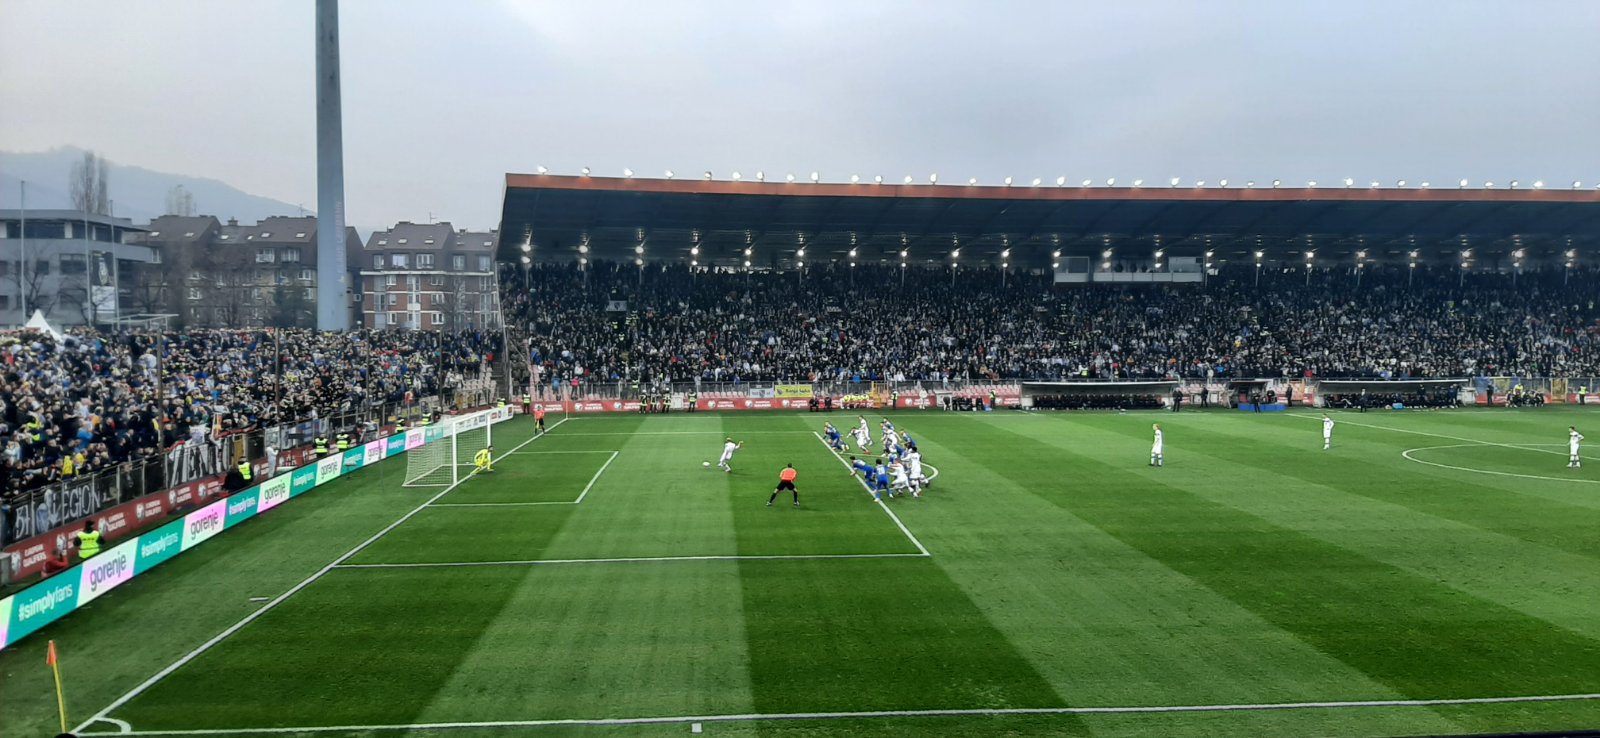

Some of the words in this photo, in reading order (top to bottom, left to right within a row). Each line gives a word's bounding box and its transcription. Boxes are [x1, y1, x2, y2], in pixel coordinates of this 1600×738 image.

[320, 457, 338, 479] gorenje
[264, 478, 286, 501] gorenje
[190, 509, 219, 540] gorenje
[141, 531, 178, 559] #simplyfans
[90, 551, 127, 592] gorenje
[18, 582, 73, 621] #simplyfans
